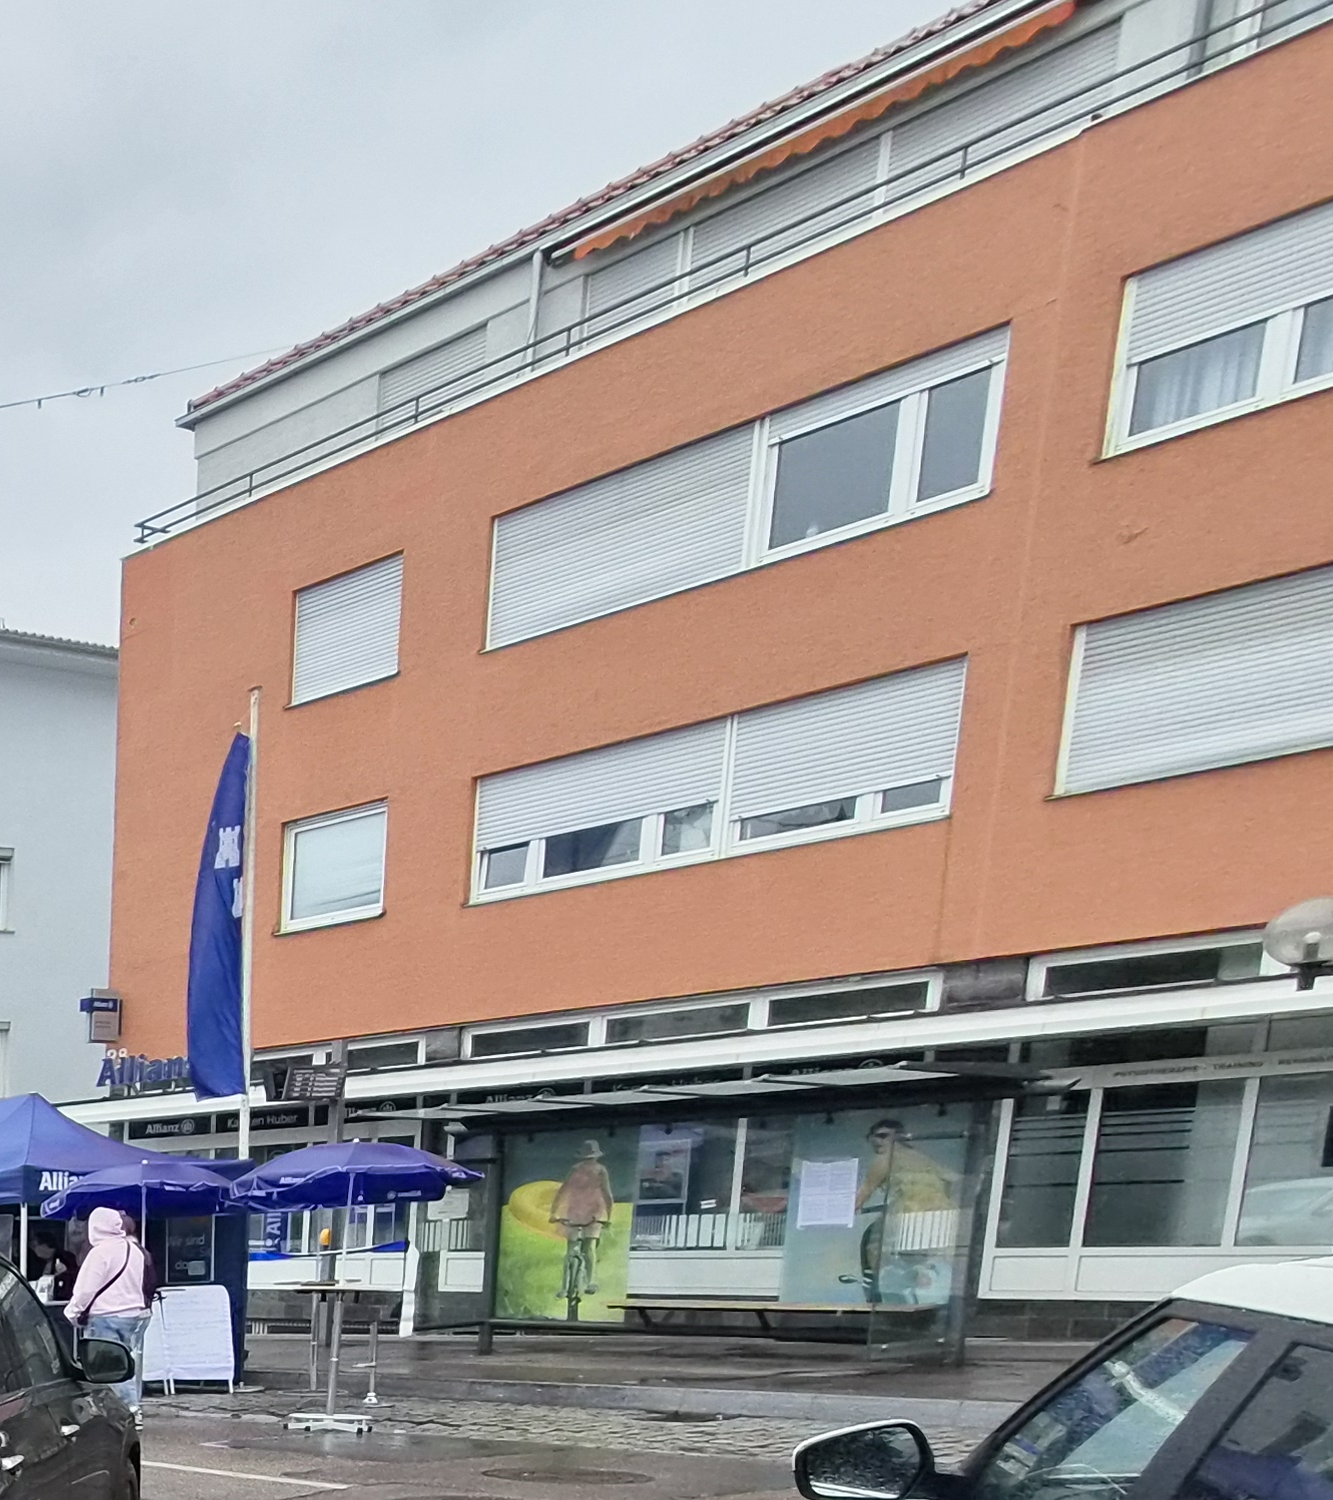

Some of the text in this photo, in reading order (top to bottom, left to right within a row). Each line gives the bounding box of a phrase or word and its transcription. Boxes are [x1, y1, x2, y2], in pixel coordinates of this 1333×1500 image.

[96, 1053, 191, 1087] Allian
[145, 1122, 180, 1134] Allianz
[267, 1114, 298, 1124] Huber
[185, 1234, 205, 1246] sind
